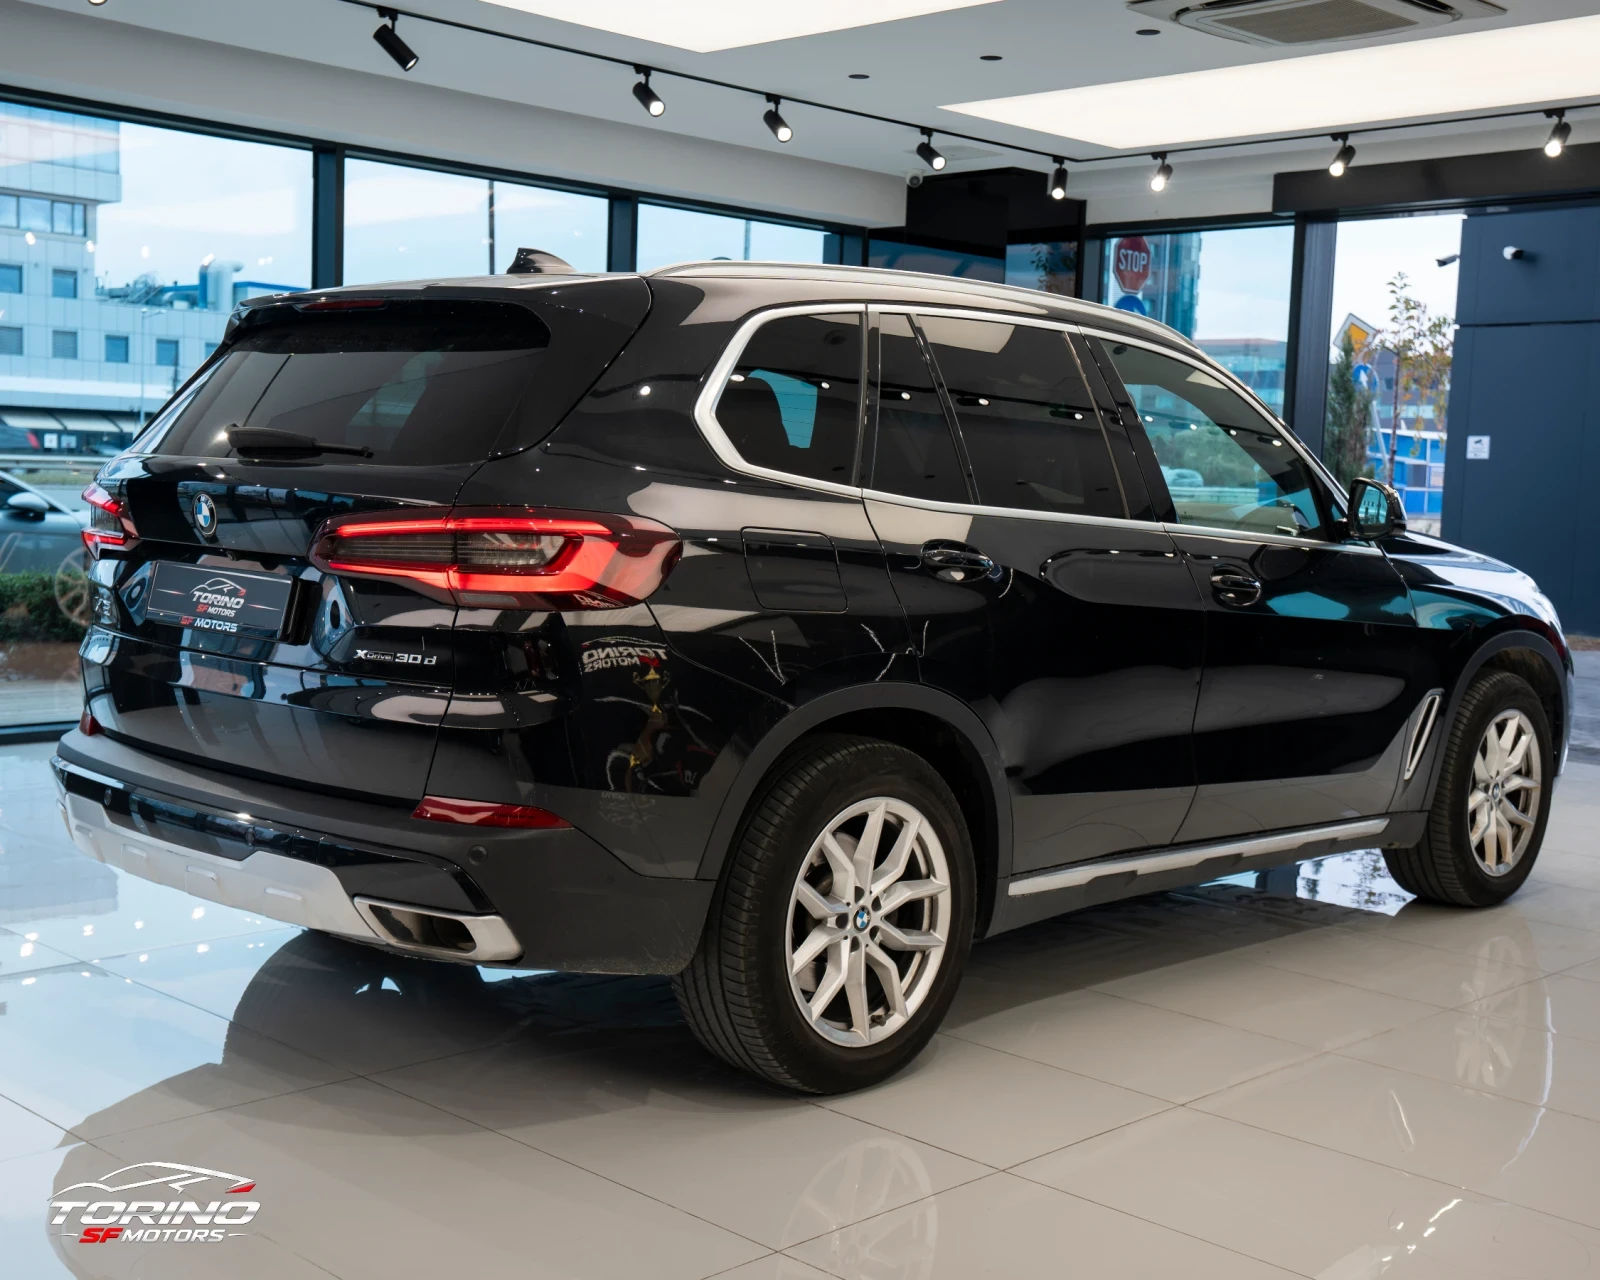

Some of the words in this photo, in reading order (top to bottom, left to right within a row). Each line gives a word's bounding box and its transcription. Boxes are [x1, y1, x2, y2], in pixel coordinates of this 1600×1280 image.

[1119, 248, 1148, 273] STOP
[192, 591, 244, 609] TORINO
[196, 604, 209, 612] SF
[207, 607, 236, 617] MOTORS
[180, 616, 194, 625] SF
[195, 617, 238, 632] MOTORS
